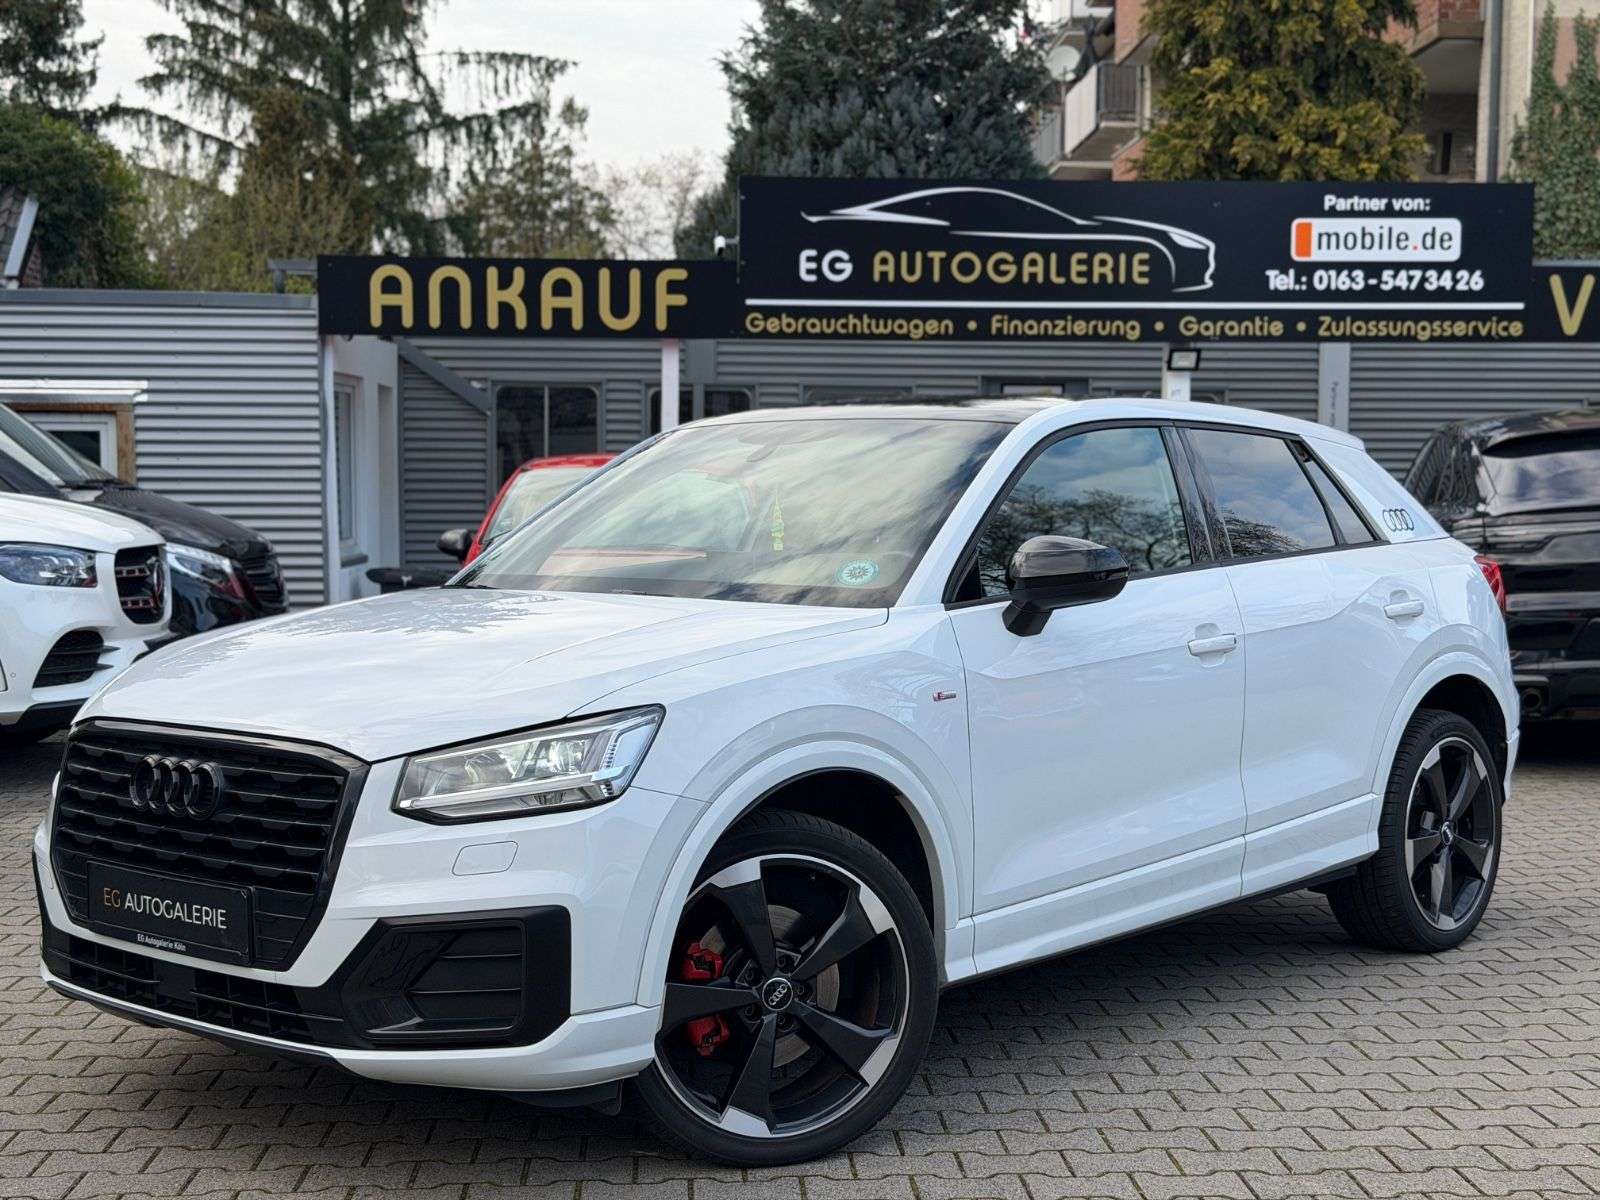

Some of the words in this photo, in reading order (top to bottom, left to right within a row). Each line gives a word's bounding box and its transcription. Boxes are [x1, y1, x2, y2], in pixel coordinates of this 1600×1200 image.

[1323, 194, 1388, 212] Partner
[1391, 197, 1431, 212] von:
[1316, 226, 1453, 251] mobile.de
[798, 248, 854, 284] EG
[873, 250, 1150, 285] AUTOGALERIE
[1265, 269, 1308, 291] Tel.:
[369, 264, 688, 331] ANKAUF
[745, 312, 954, 340] Gebrauchtwagen
[991, 314, 1141, 341] Finanzierung
[1178, 315, 1284, 337] Garantie
[1317, 315, 1524, 342] Zulassungsservice
[103, 887, 121, 908] EG
[124, 892, 227, 929] AUTOGALERIE
